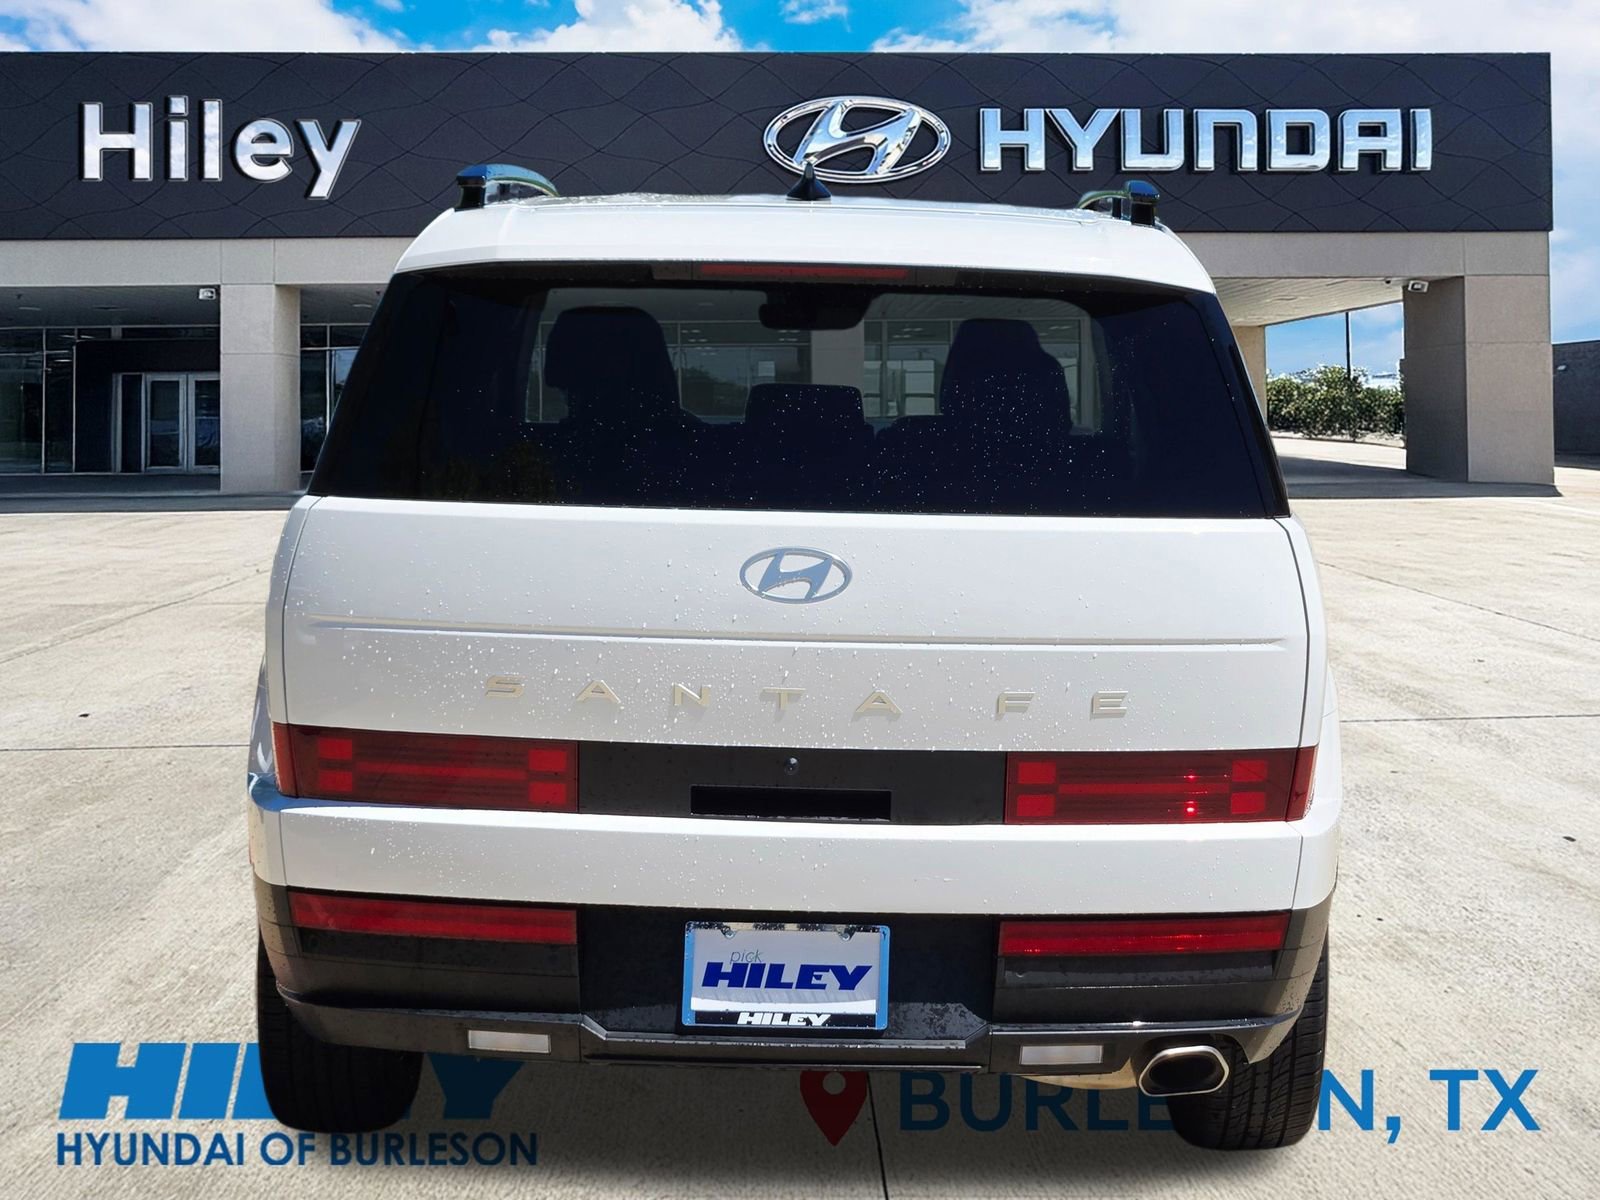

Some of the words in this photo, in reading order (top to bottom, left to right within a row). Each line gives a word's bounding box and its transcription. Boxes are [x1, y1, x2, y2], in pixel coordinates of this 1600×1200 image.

[80, 95, 361, 199] Hiley
[979, 107, 1432, 172] HYUNDAI
[485, 674, 903, 715] SANTA
[997, 690, 1128, 718] FE
[729, 949, 763, 964] pick
[702, 962, 873, 990] HILEY
[737, 1012, 831, 1026] HILEY
